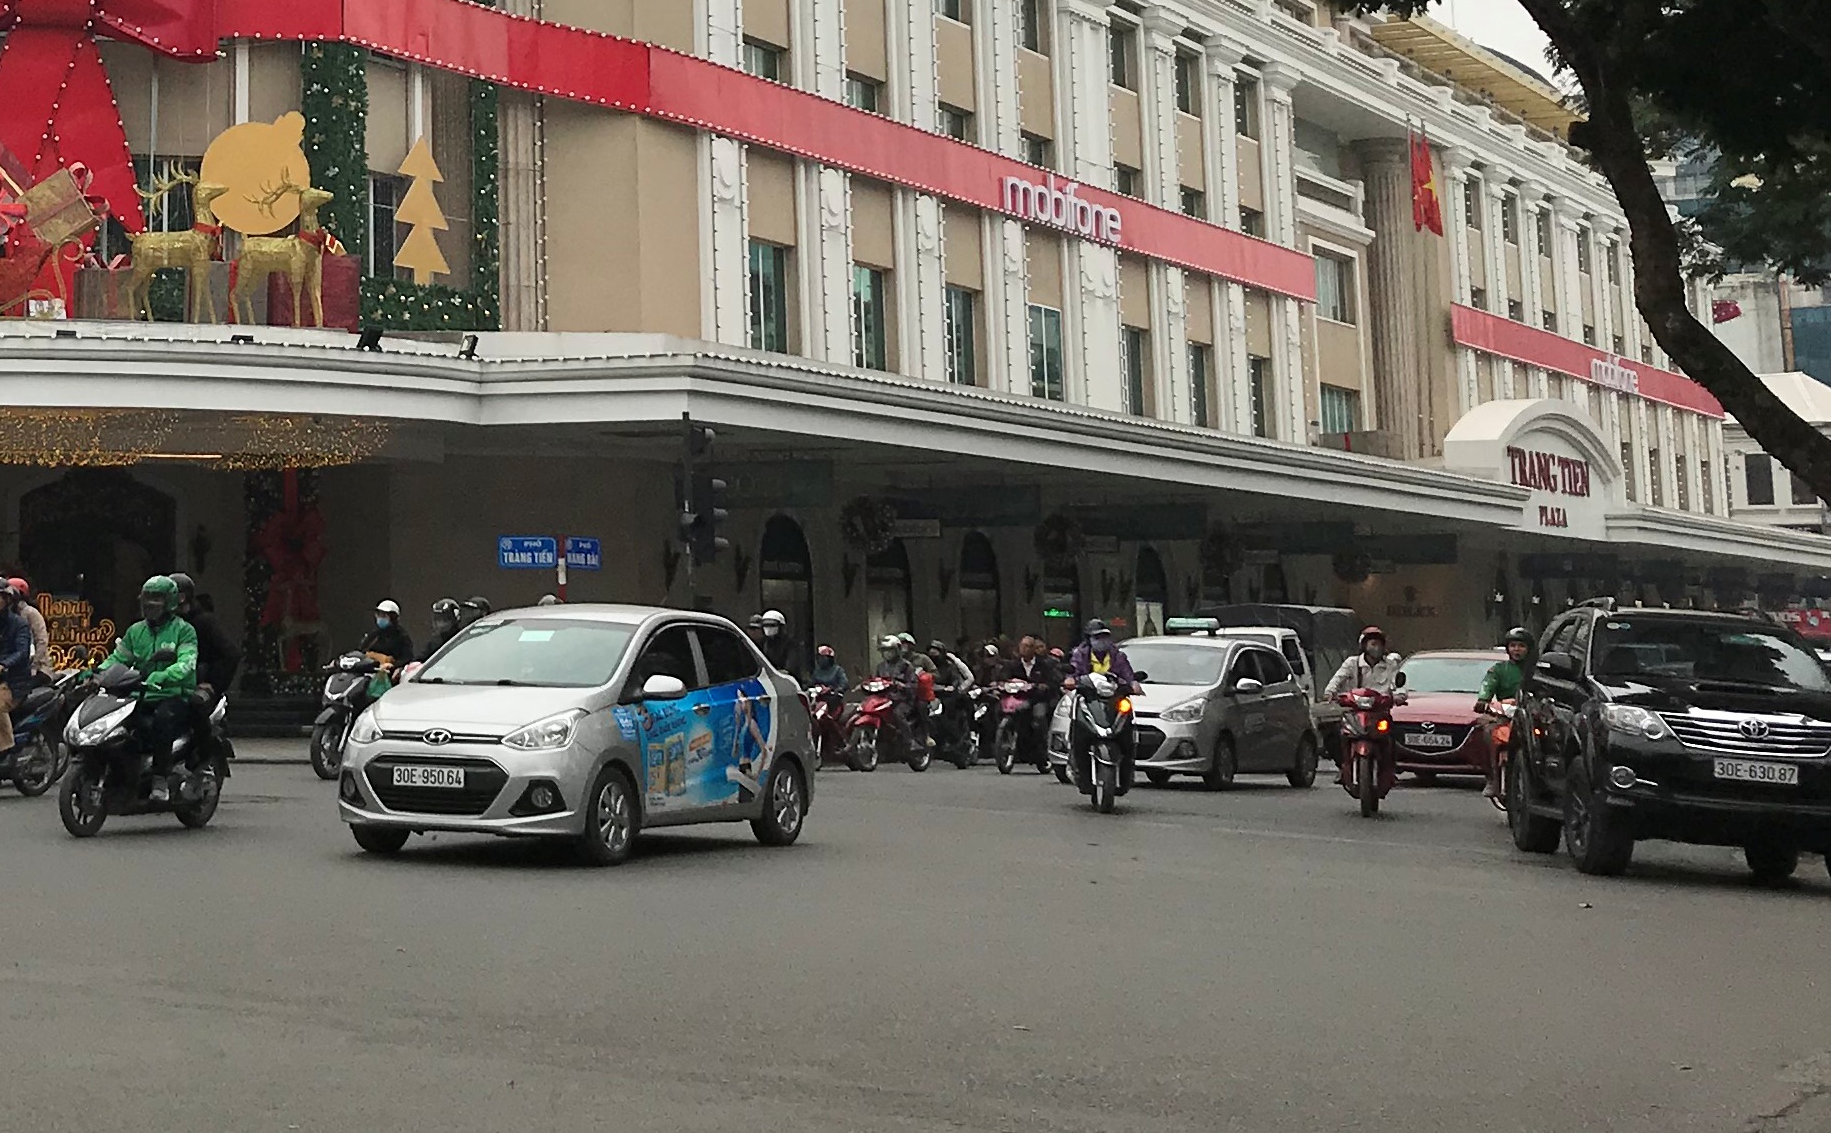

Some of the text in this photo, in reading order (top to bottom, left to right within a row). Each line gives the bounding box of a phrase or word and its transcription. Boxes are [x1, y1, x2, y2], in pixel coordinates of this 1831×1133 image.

[1002, 173, 1122, 243] mobifone
[1507, 445, 1591, 498] TRANG TIEN
[1538, 505, 1568, 528] PLAZA
[37, 593, 94, 627] Merry
